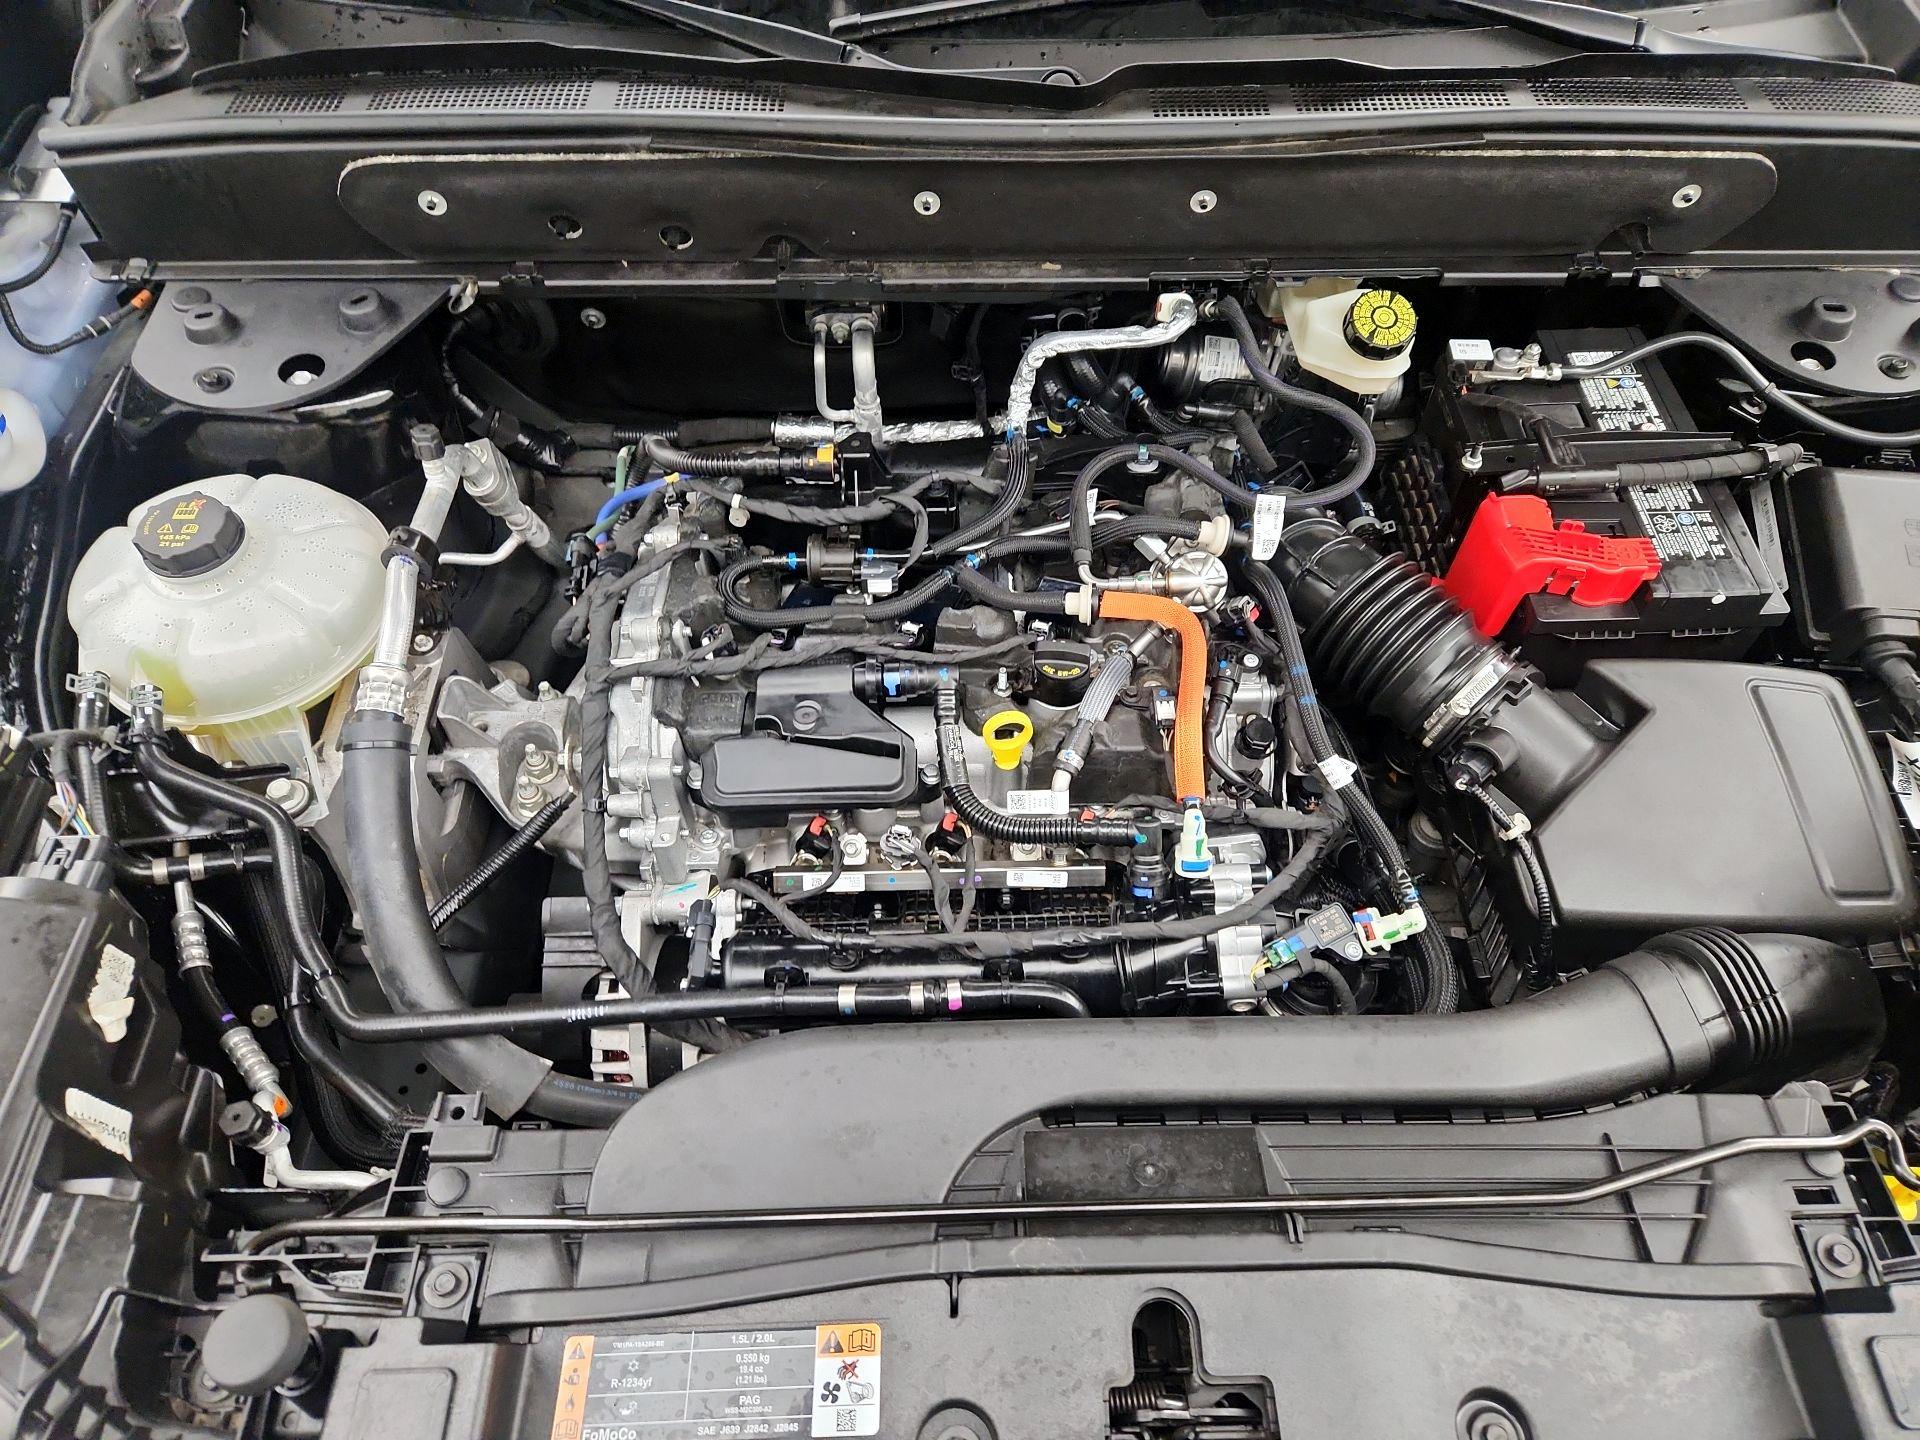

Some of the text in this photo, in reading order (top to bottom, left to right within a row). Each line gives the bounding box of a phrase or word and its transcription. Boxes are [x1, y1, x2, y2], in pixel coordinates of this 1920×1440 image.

[731, 1335, 750, 1344] 1.5L
[756, 1333, 776, 1343] 2.0L
[735, 1353, 770, 1365] 0.550 kg
[739, 1365, 764, 1374] 19.4 oz
[610, 1377, 653, 1389] R-1234yf
[735, 1375, 768, 1386] (1.21 lbs)
[739, 1395, 761, 1406] PAG
[581, 1427, 637, 1440] FoMoCo
[697, 1425, 717, 1436] SAE
[719, 1424, 741, 1435] J639
